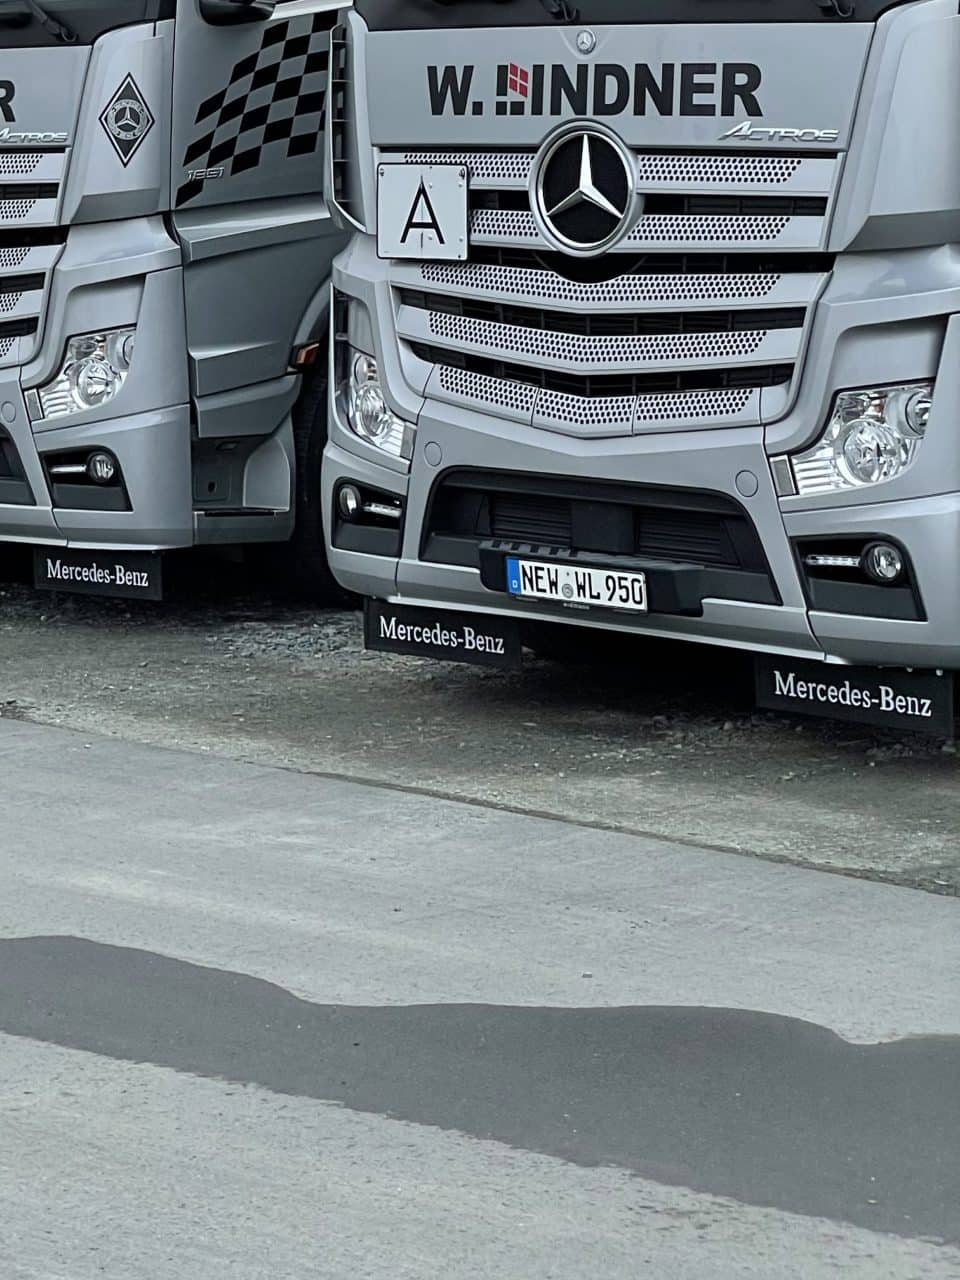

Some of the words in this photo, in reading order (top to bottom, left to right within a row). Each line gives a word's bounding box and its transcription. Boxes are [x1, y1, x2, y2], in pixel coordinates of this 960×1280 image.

[426, 64, 484, 117] W.
[496, 62, 764, 118] LINDNER
[400, 178, 446, 245] A
[46, 557, 150, 588] Mercedes-Benz
[521, 564, 559, 595] NEW
[574, 570, 601, 600] WL
[605, 574, 644, 606] 950
[379, 614, 506, 655] Mercedes-Benz
[773, 669, 934, 718] Mercedes-Benz
